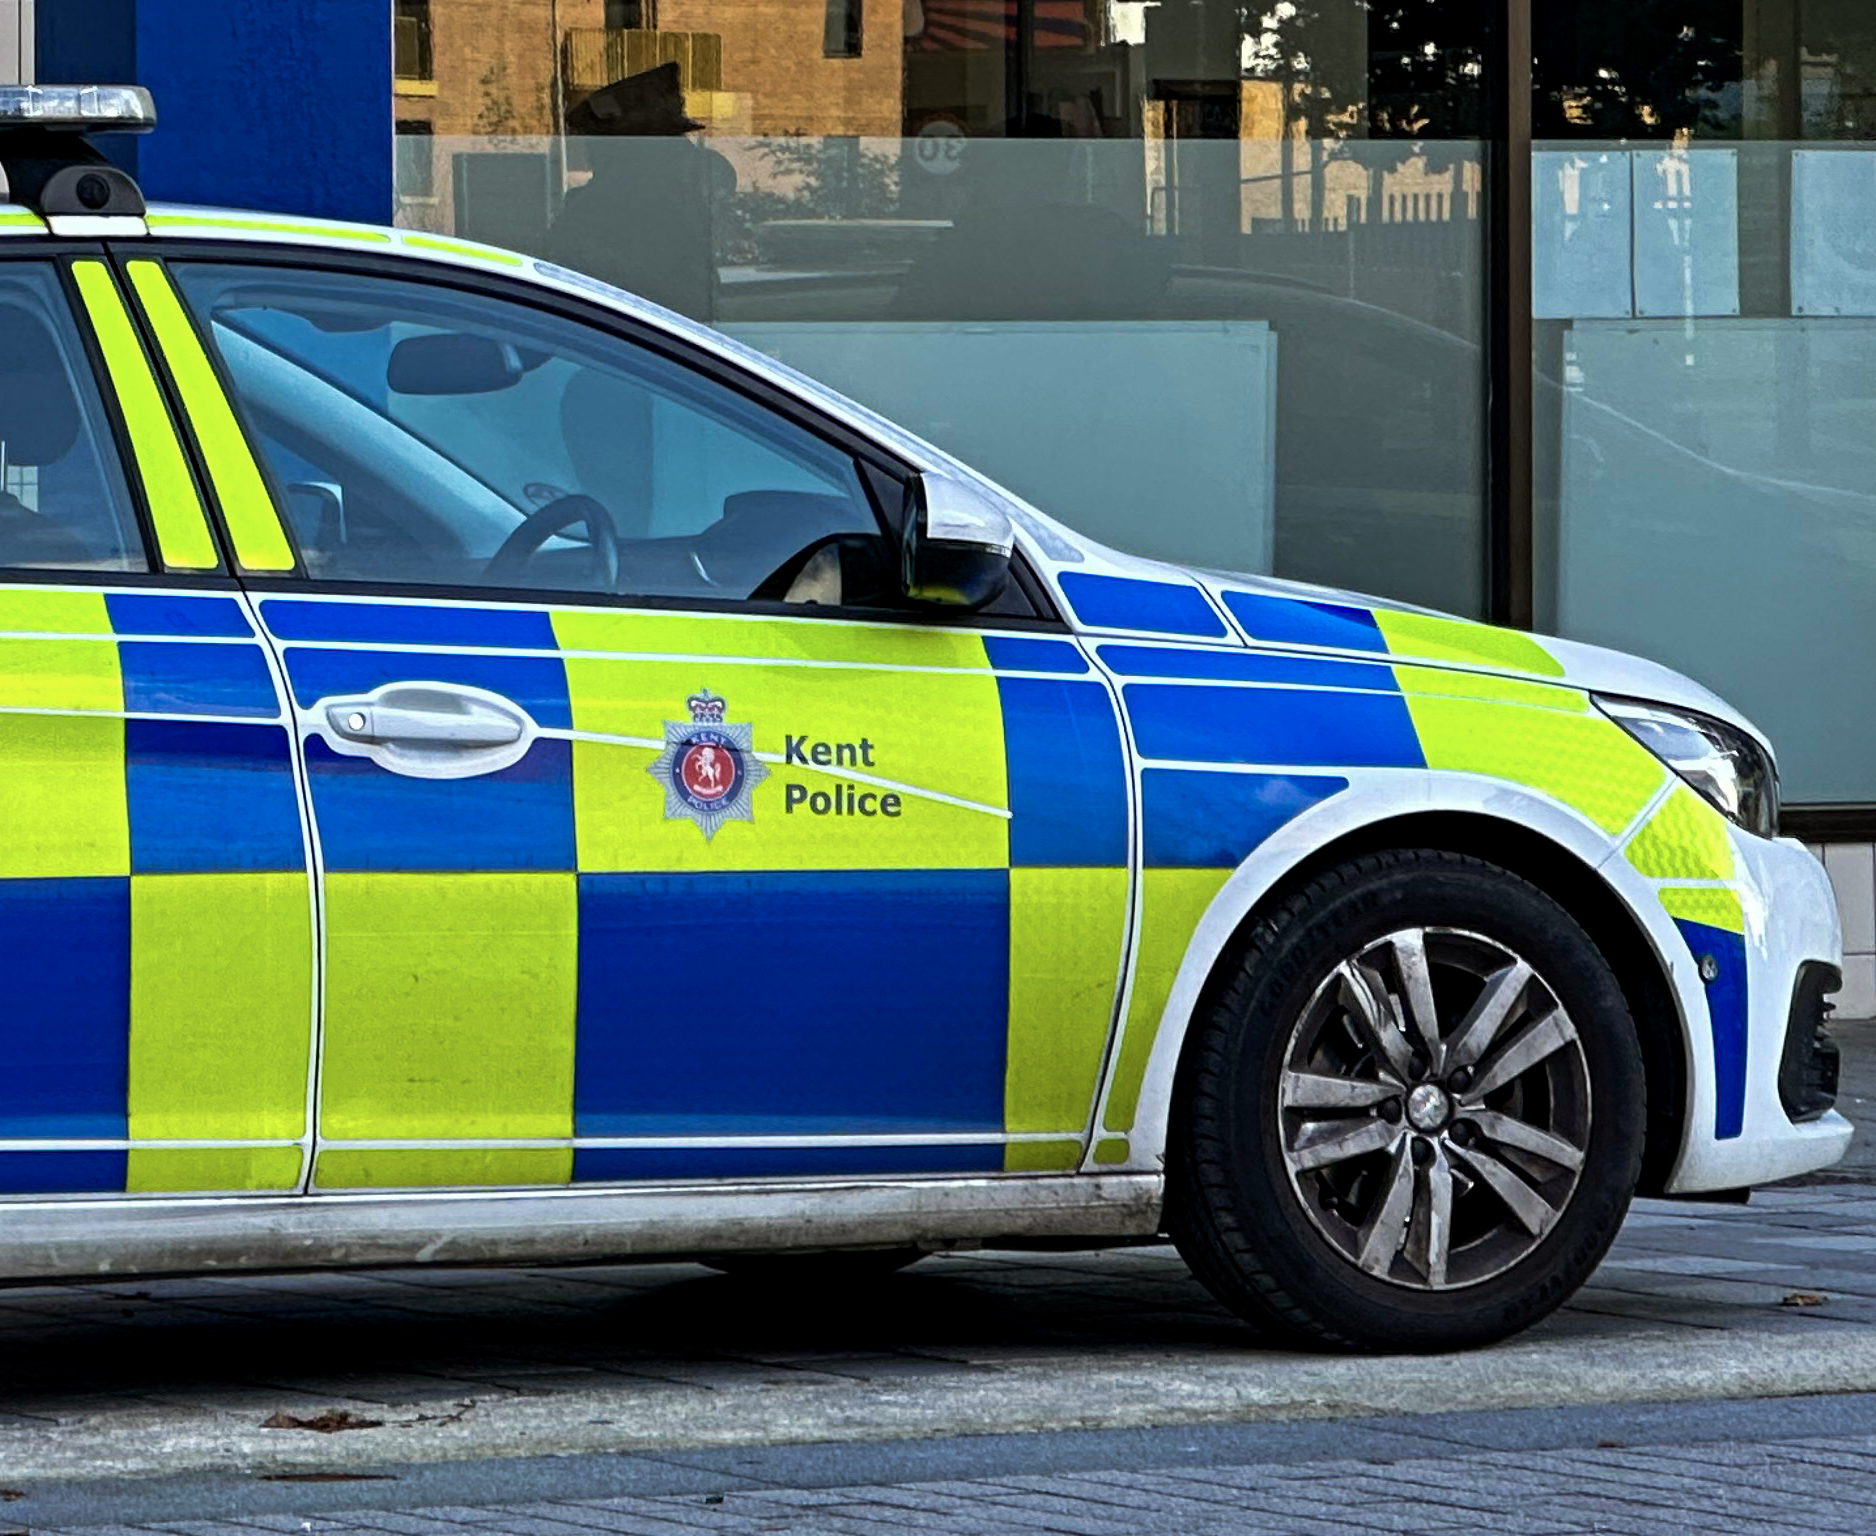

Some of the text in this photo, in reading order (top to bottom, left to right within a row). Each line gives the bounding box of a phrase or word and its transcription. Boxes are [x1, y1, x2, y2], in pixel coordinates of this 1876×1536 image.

[691, 732, 727, 745] KENT
[785, 734, 875, 767] Kent
[687, 795, 729, 811] POLICE
[785, 783, 902, 818] Police
